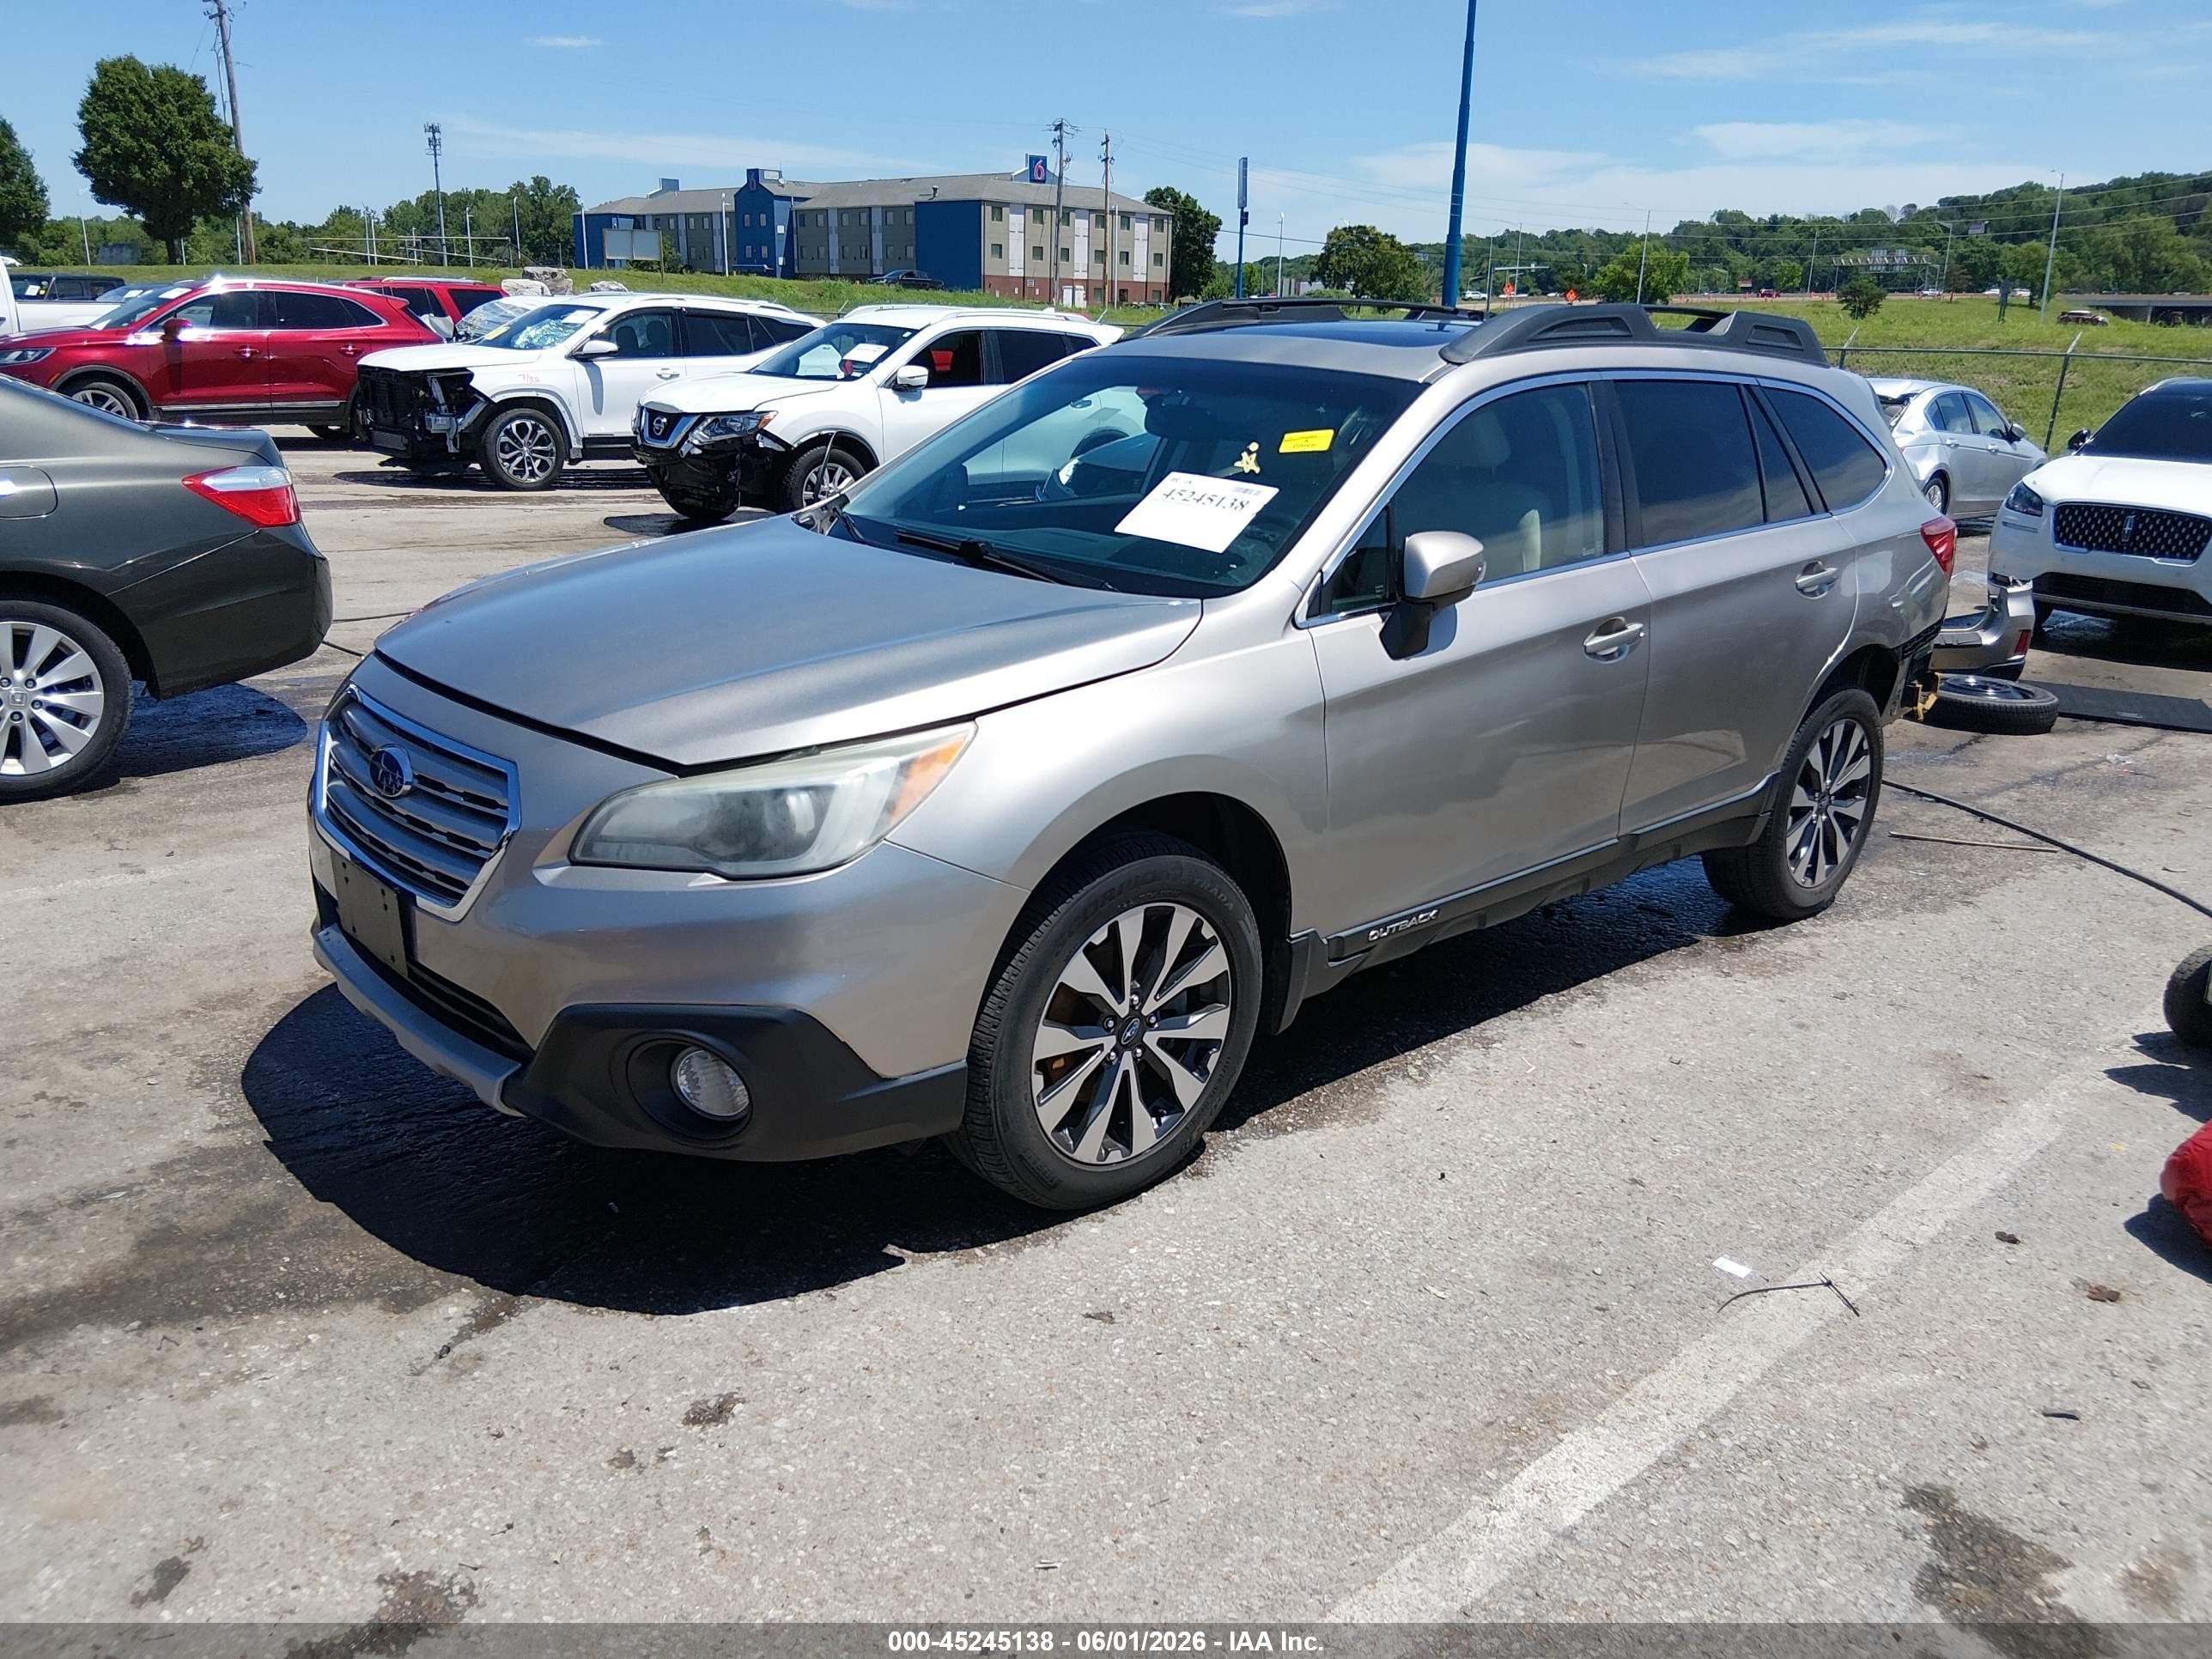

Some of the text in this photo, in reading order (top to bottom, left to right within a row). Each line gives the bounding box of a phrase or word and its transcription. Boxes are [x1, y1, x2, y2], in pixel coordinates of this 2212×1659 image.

[1033, 160, 1045, 180] 6
[1163, 488, 1249, 511] 45245138
[1368, 909, 1438, 942] OUTBACK
